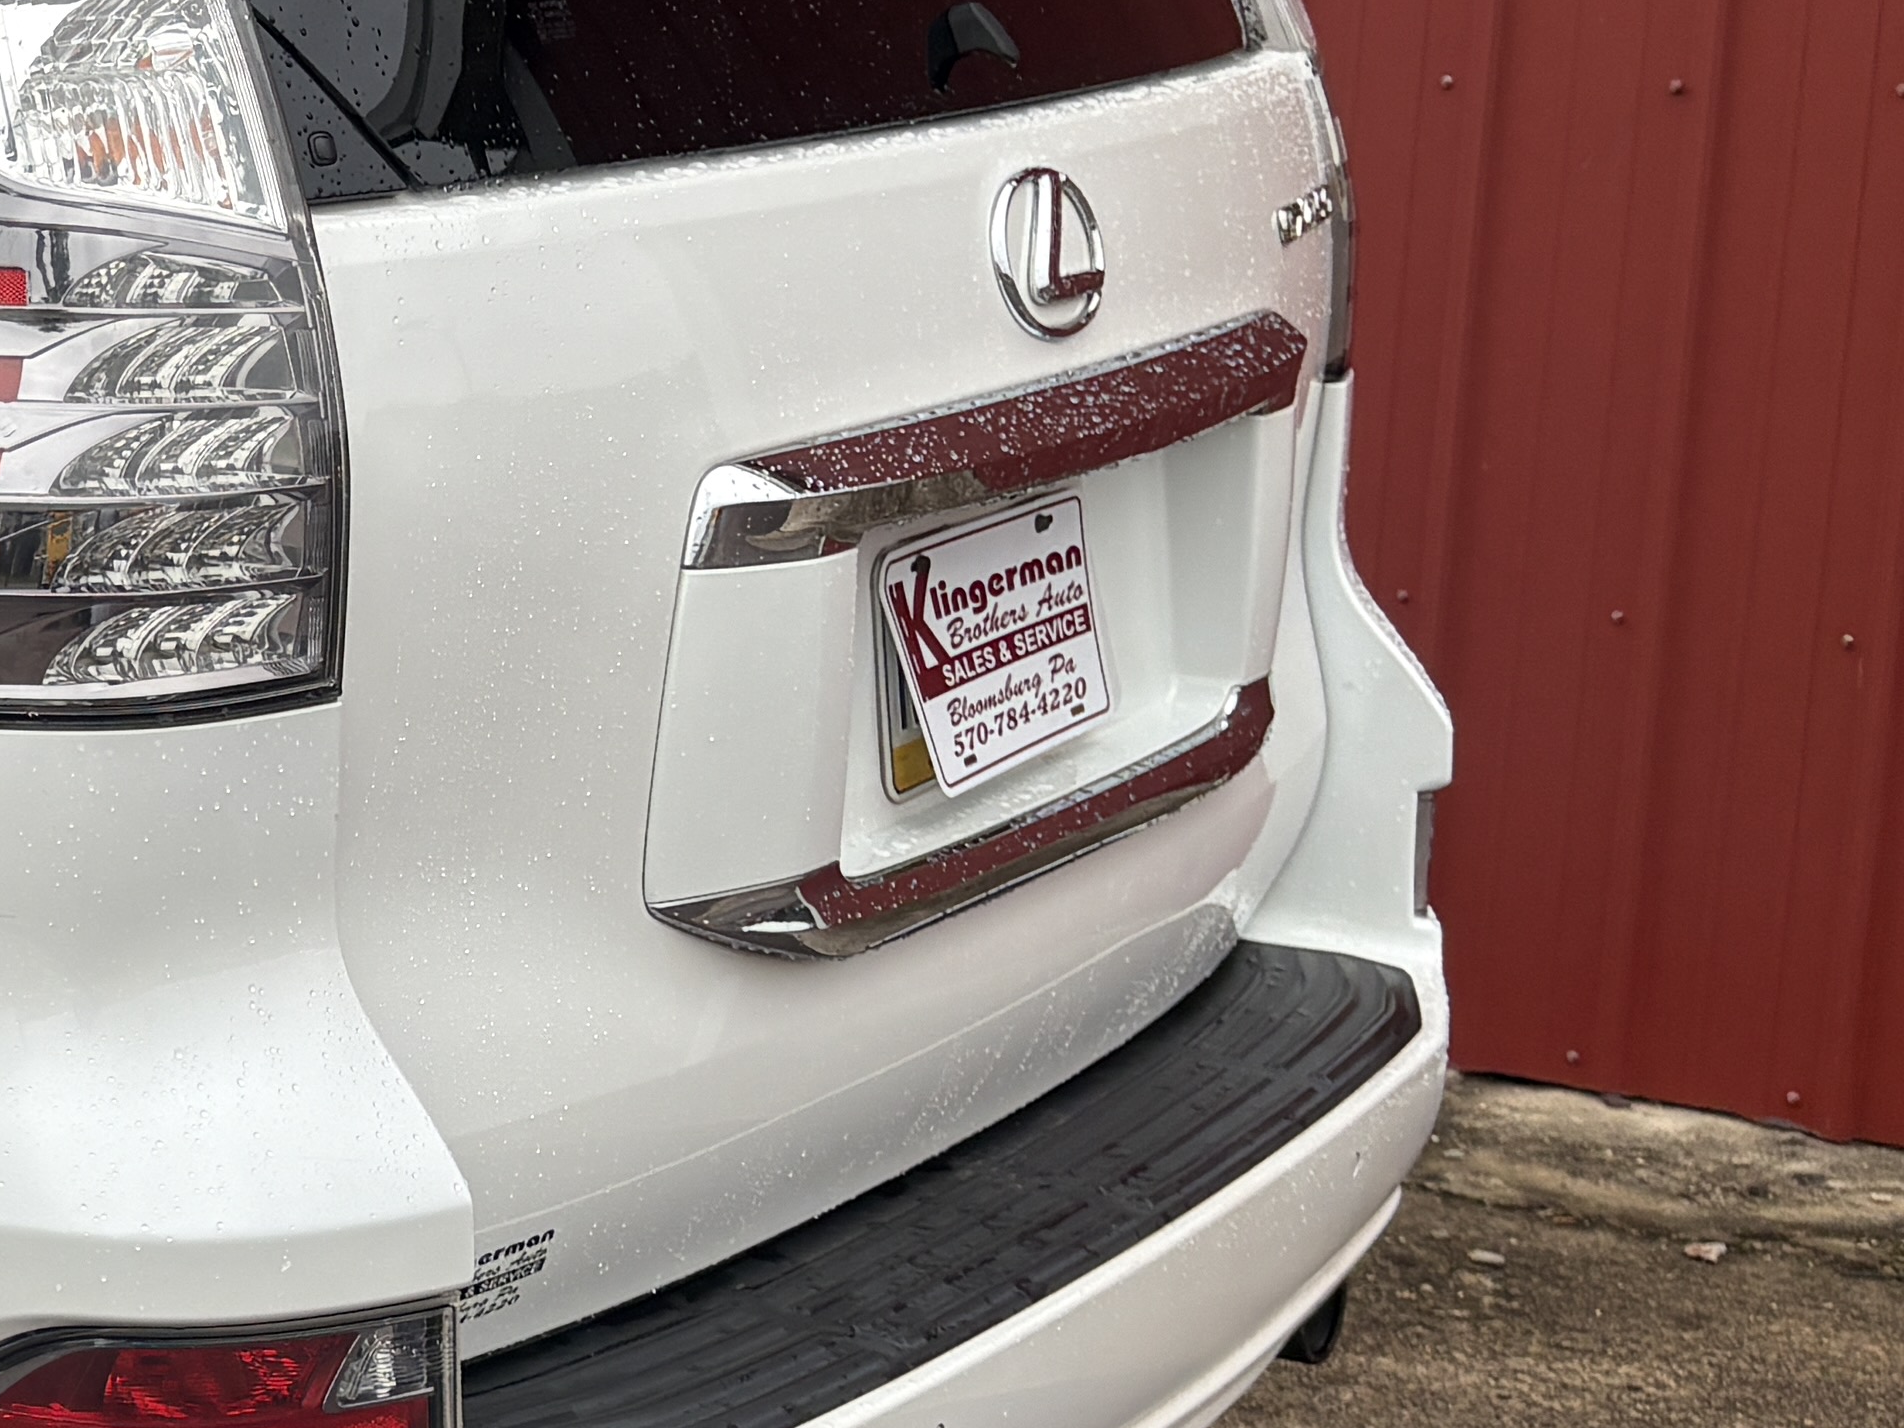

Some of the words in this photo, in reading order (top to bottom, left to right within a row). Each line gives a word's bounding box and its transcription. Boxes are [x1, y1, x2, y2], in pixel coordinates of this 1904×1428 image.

[889, 544, 1082, 669] Klingerman
[946, 602, 1028, 650] Brothers
[1035, 580, 1085, 618] Auto
[942, 646, 997, 688] SALES
[999, 639, 1013, 664] &
[1013, 608, 1088, 657] SERVICE
[946, 672, 1044, 728] Bloomsburg
[1048, 652, 1077, 684] Pa
[953, 676, 1088, 758] 570-784-4220
